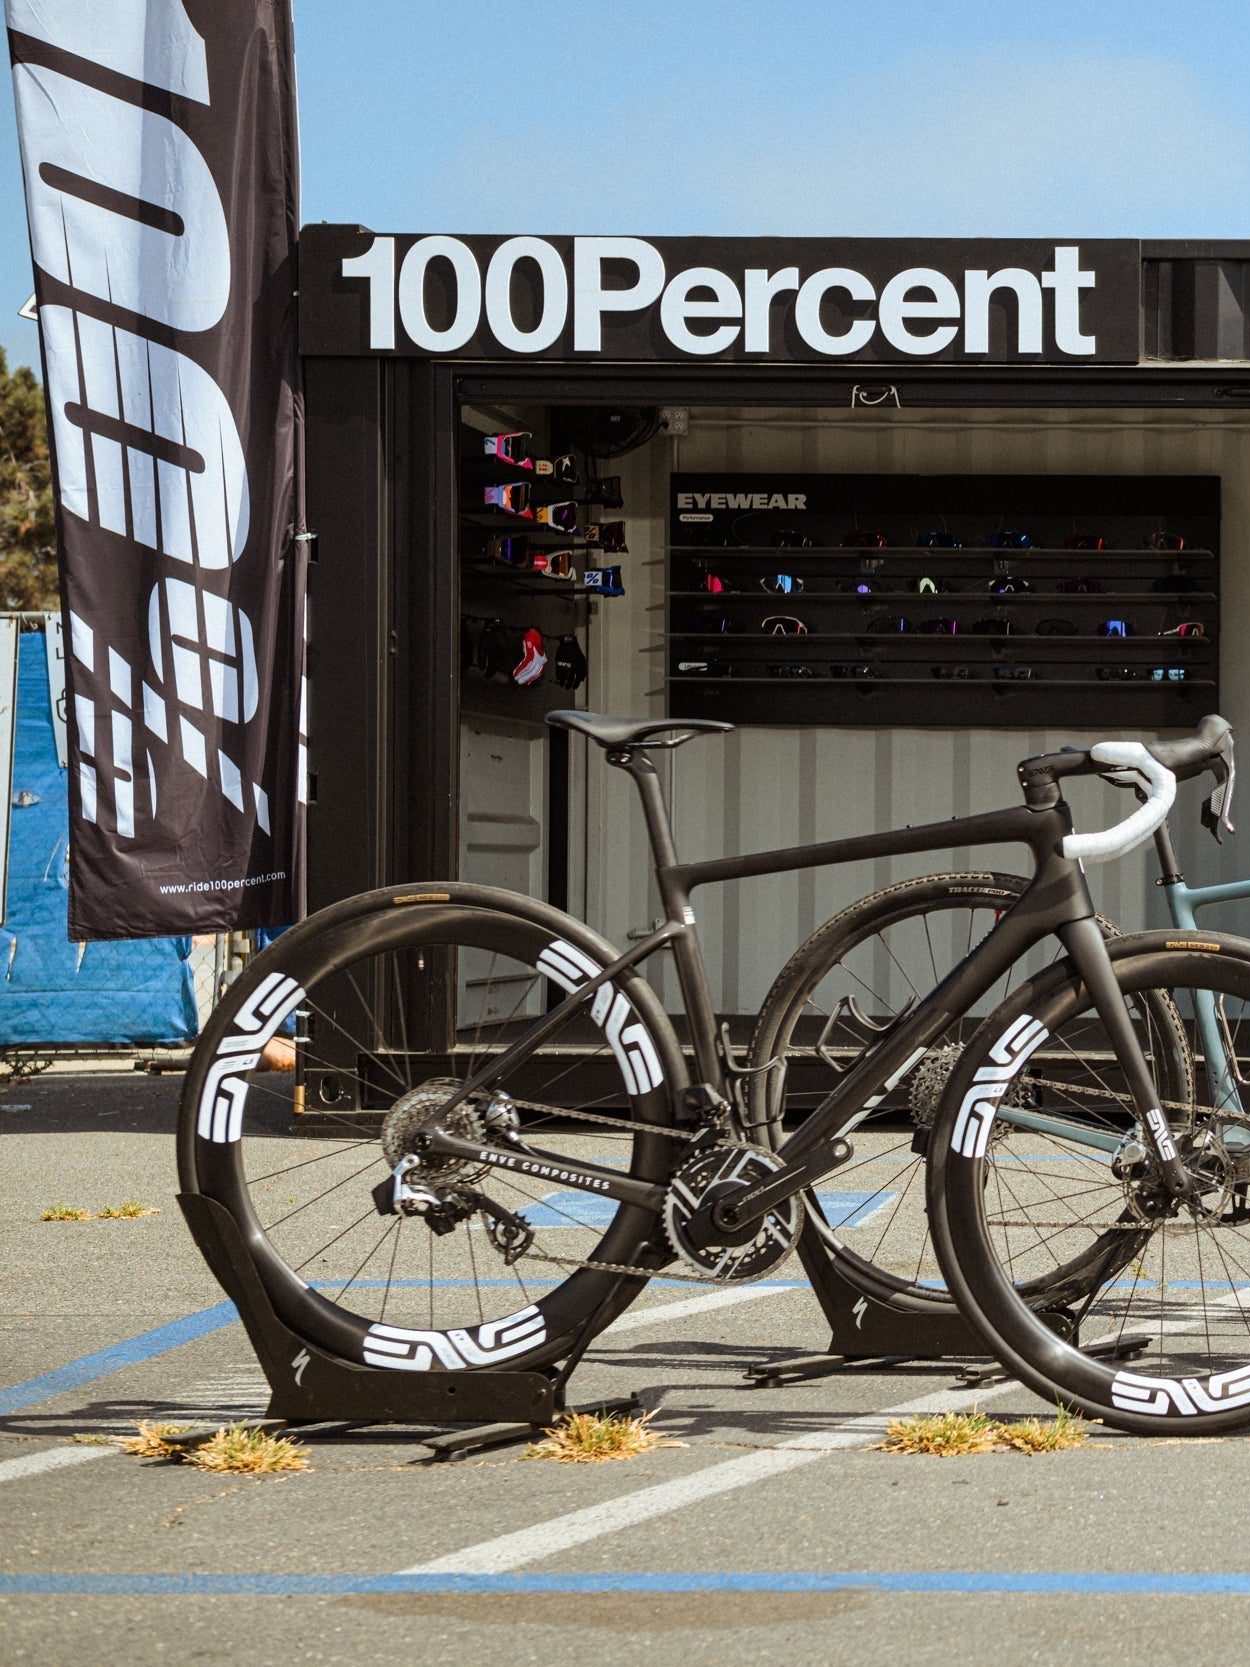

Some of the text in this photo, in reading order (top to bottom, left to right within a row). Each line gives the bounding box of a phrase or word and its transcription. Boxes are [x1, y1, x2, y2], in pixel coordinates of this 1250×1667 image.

[341, 236, 1096, 355] 100Percent
[677, 493, 807, 510] EYEWEAR
[160, 871, 286, 894] www.ride100percent.com
[197, 972, 307, 1143] ENVE
[951, 1014, 1050, 1158] ENVE
[480, 1151, 610, 1190] ENVE COMPOSITES
[362, 1305, 547, 1371] ENVE
